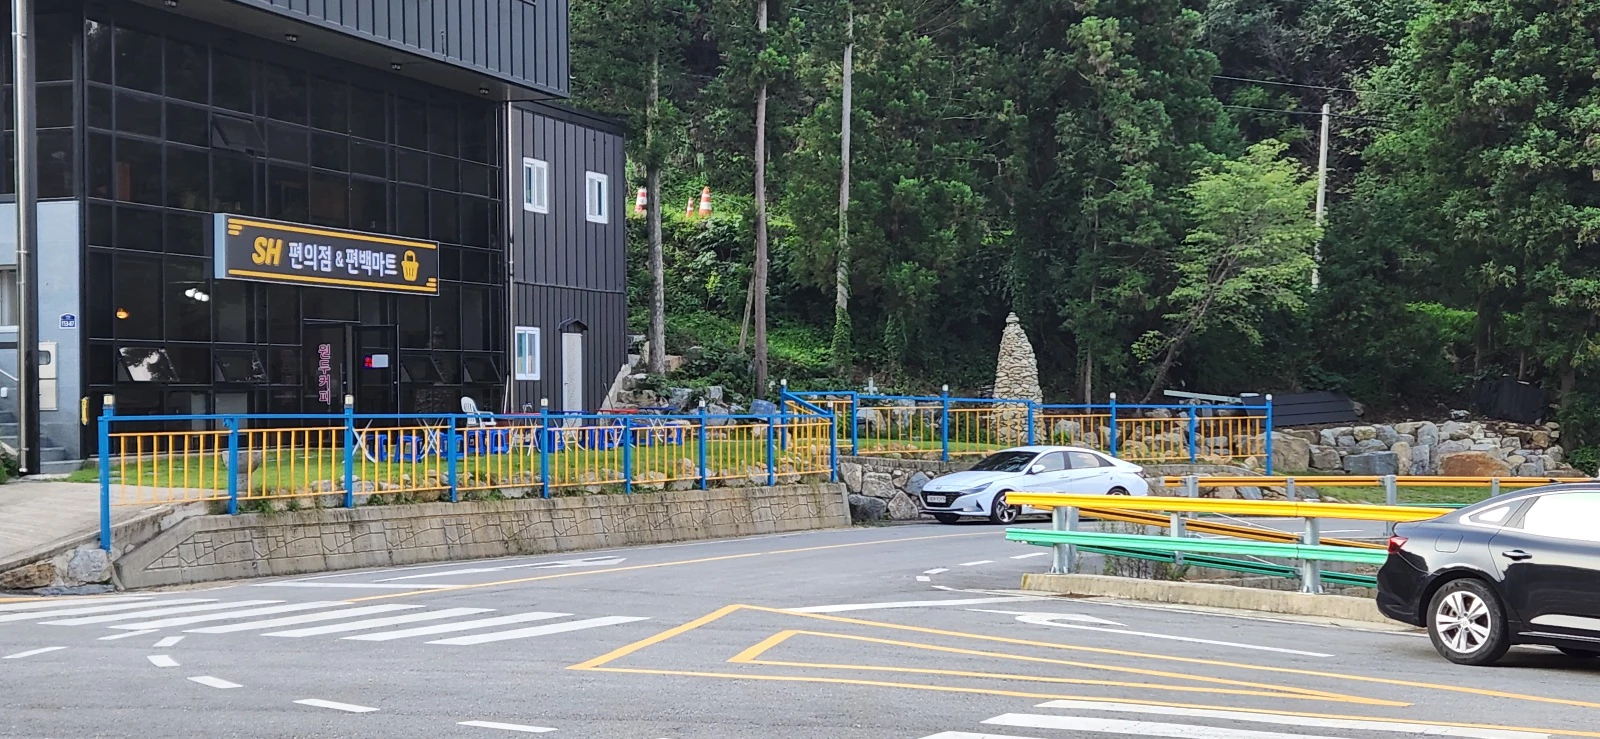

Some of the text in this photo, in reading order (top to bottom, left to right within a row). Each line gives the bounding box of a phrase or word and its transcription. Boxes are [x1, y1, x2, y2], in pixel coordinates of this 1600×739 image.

[251, 236, 398, 277] SH 편의점 & 편백마트
[318, 343, 331, 405] 원두커피
